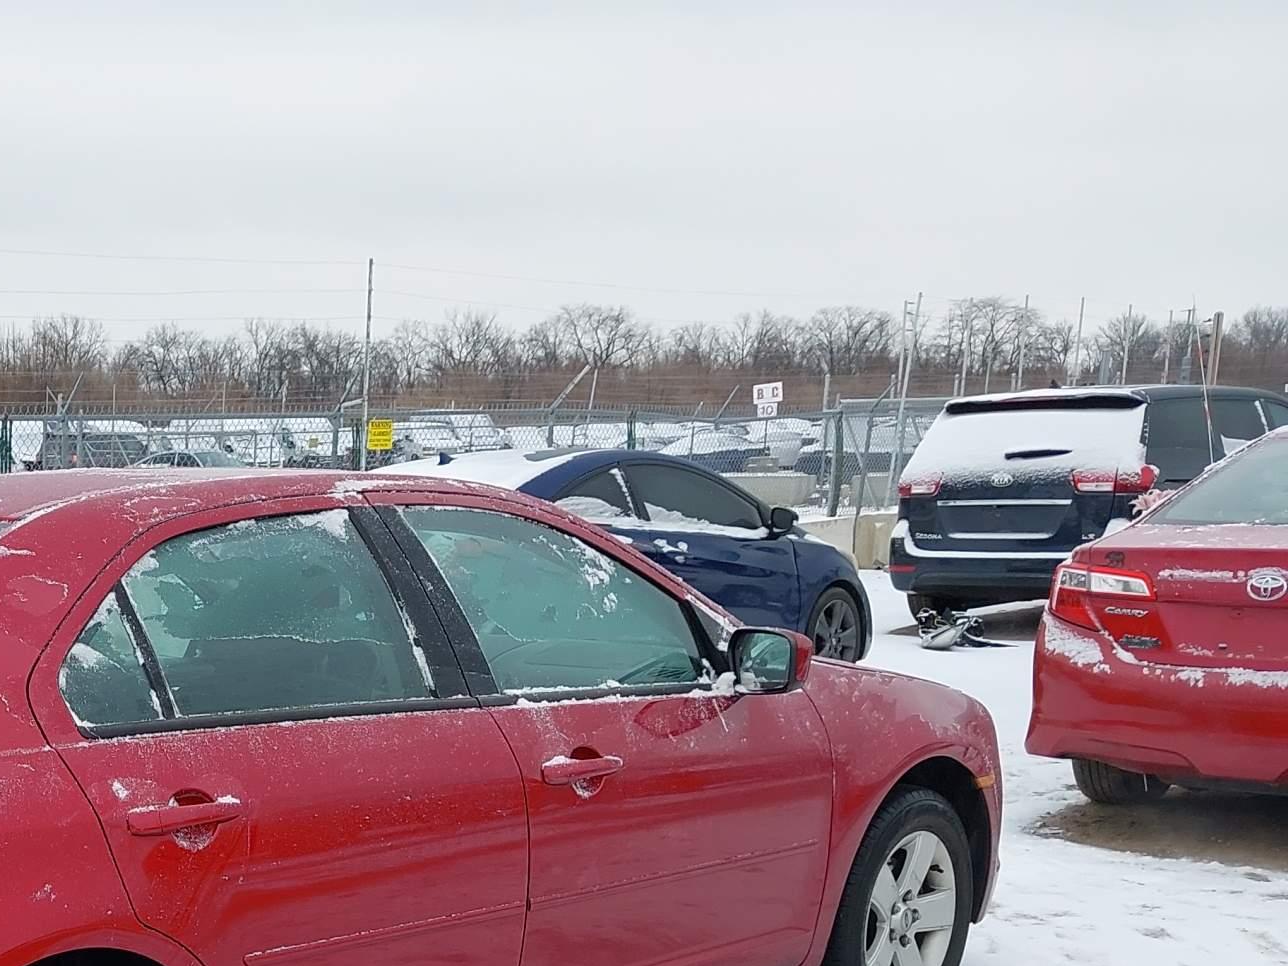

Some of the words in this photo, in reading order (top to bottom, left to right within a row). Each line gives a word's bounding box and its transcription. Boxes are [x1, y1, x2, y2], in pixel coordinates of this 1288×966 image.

[757, 388, 764, 399] B
[772, 386, 779, 398] C
[759, 405, 774, 415] 10
[1104, 606, 1149, 618] CAMRY
